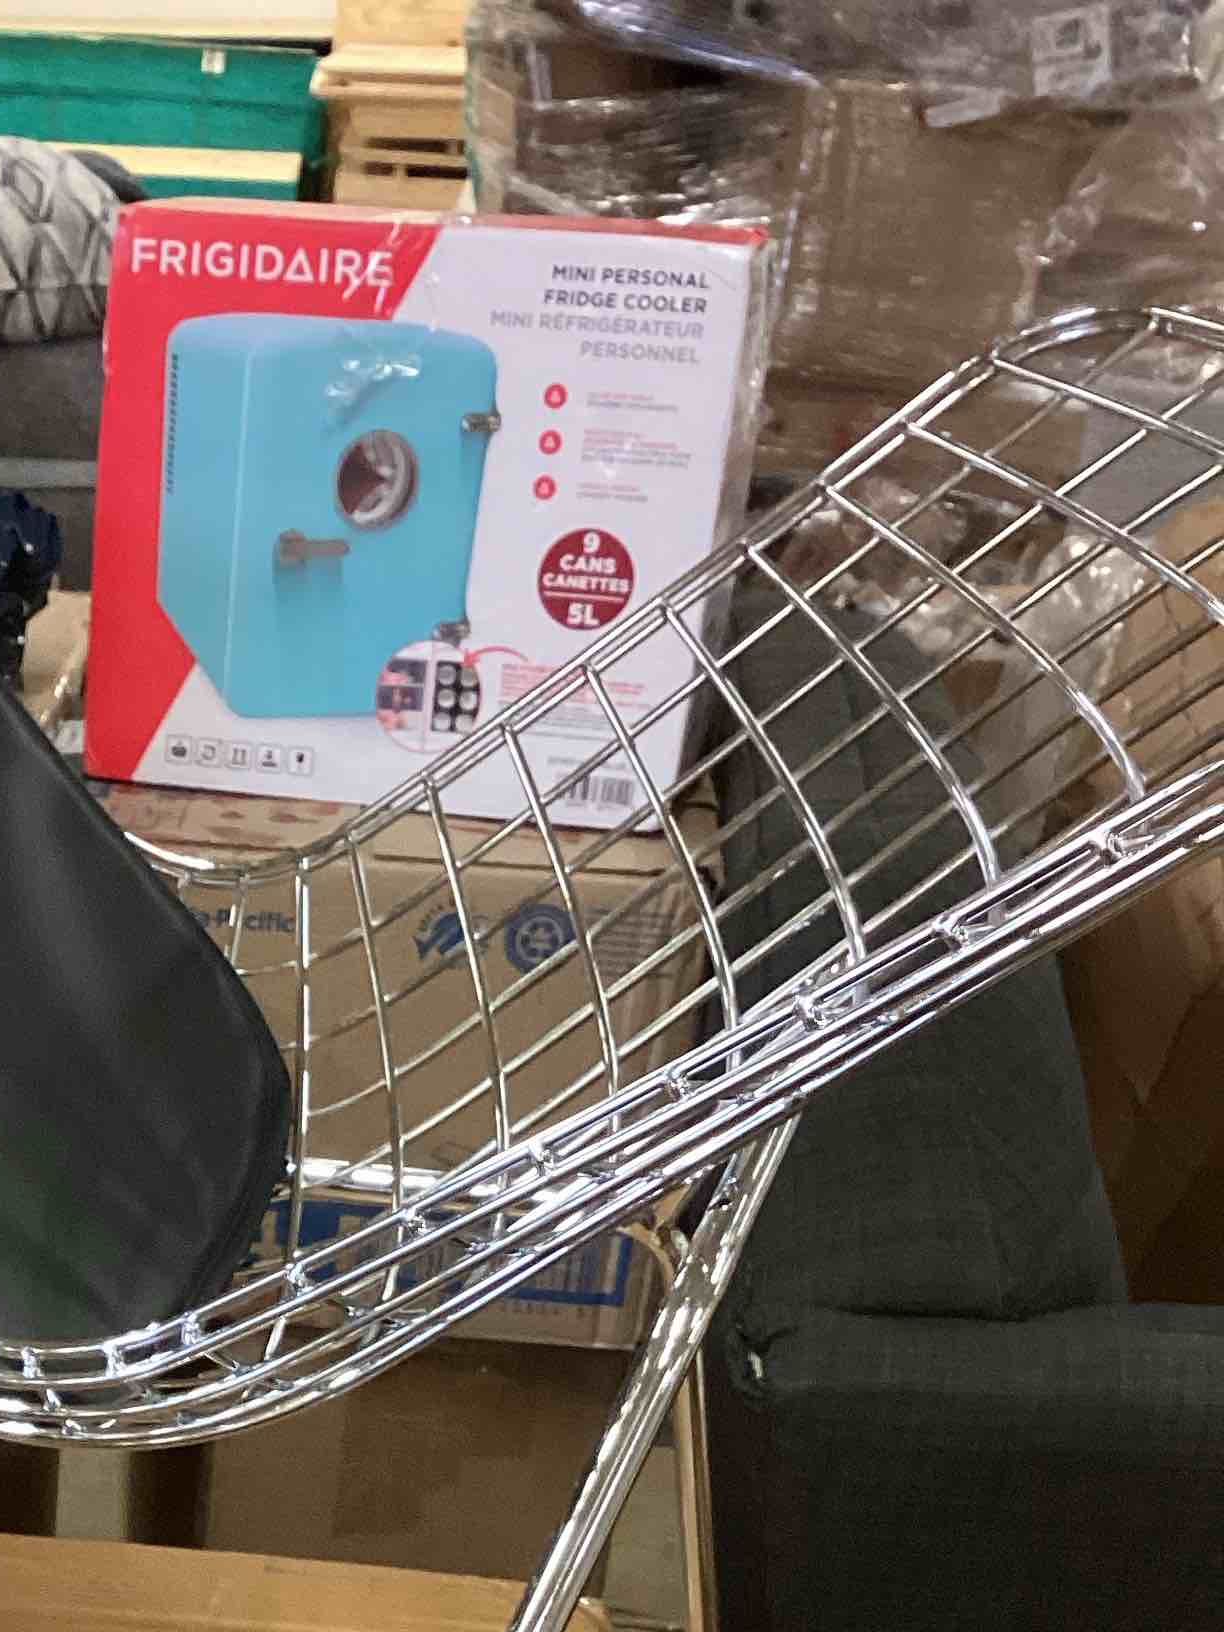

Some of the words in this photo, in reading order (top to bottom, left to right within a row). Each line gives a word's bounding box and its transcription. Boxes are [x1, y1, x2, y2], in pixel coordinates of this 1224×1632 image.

[130, 235, 394, 288] FRIGIDAIRE
[551, 264, 595, 282] MINI
[601, 267, 711, 289] PERSONAL
[543, 289, 617, 309] FRIDGE
[623, 294, 708, 313] COOLER
[489, 310, 532, 329] MINI
[579, 340, 700, 364] PERSONNEL
[583, 531, 601, 554] 9
[559, 553, 617, 575] CANS
[542, 572, 629, 593] CANETTES
